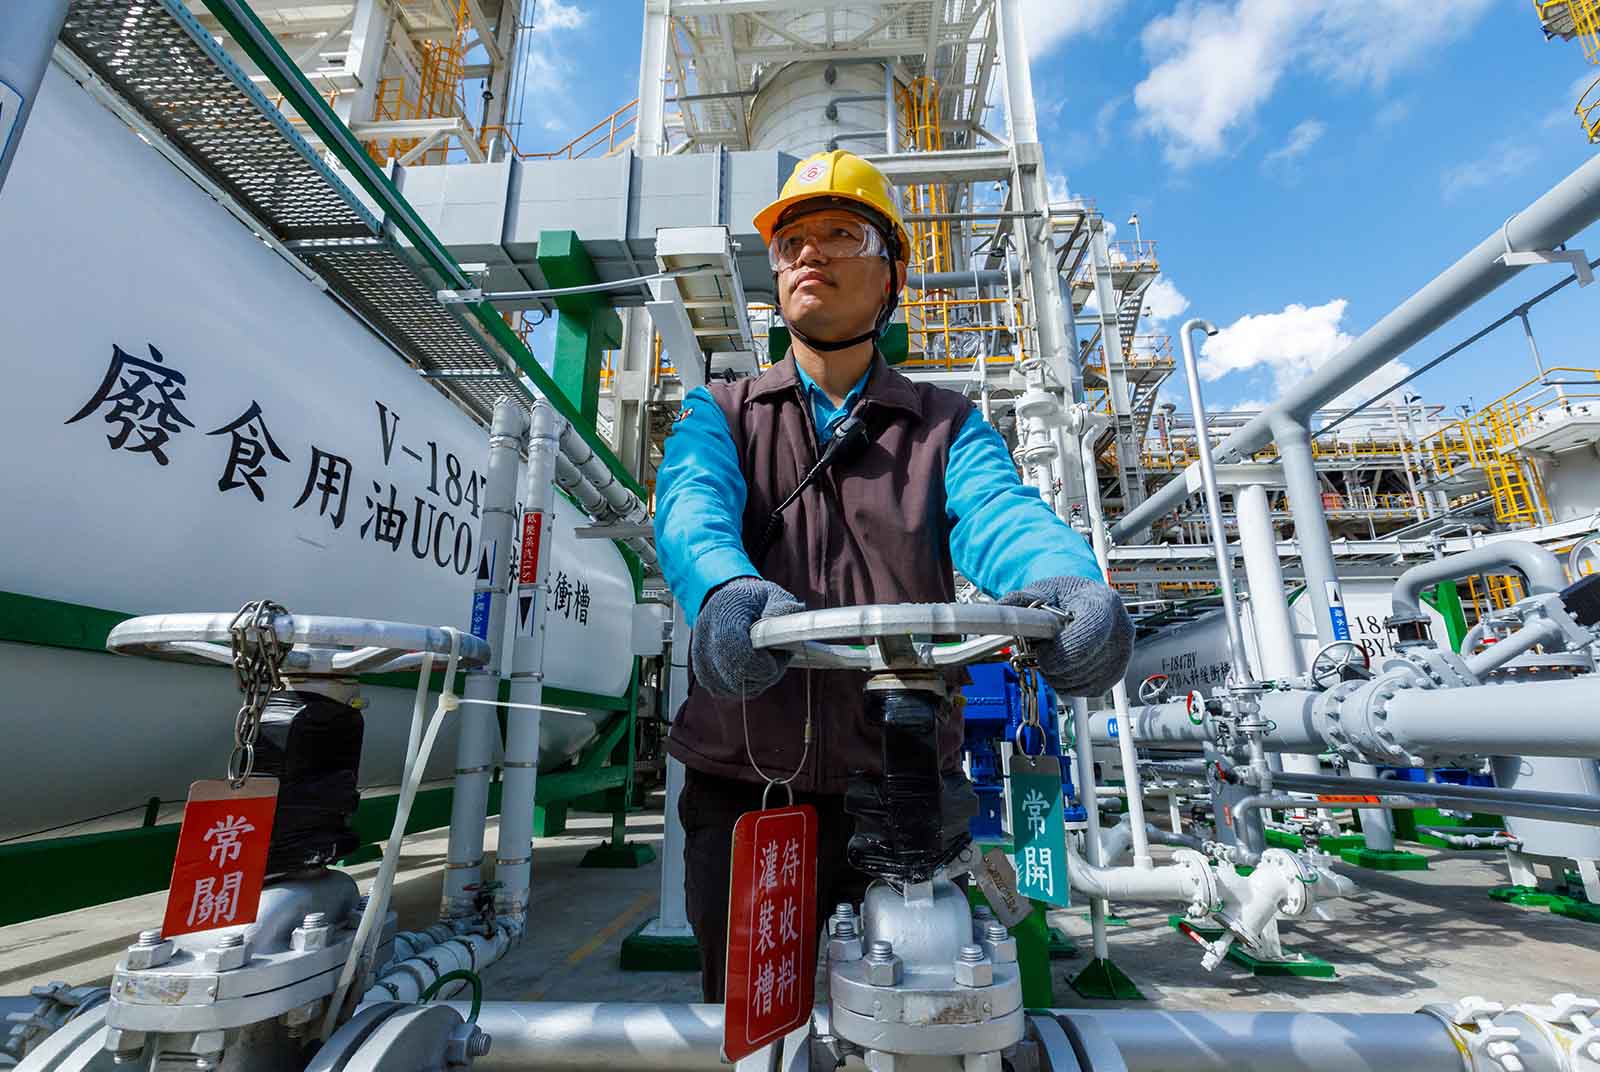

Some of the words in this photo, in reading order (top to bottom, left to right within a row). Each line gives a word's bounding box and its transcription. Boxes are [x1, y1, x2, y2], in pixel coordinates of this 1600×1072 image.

[186, 815, 255, 927] 常關
[1021, 790, 1054, 897] 常開
[752, 842, 780, 1018] 灌裝槽
[776, 841, 801, 1005] 待收料
